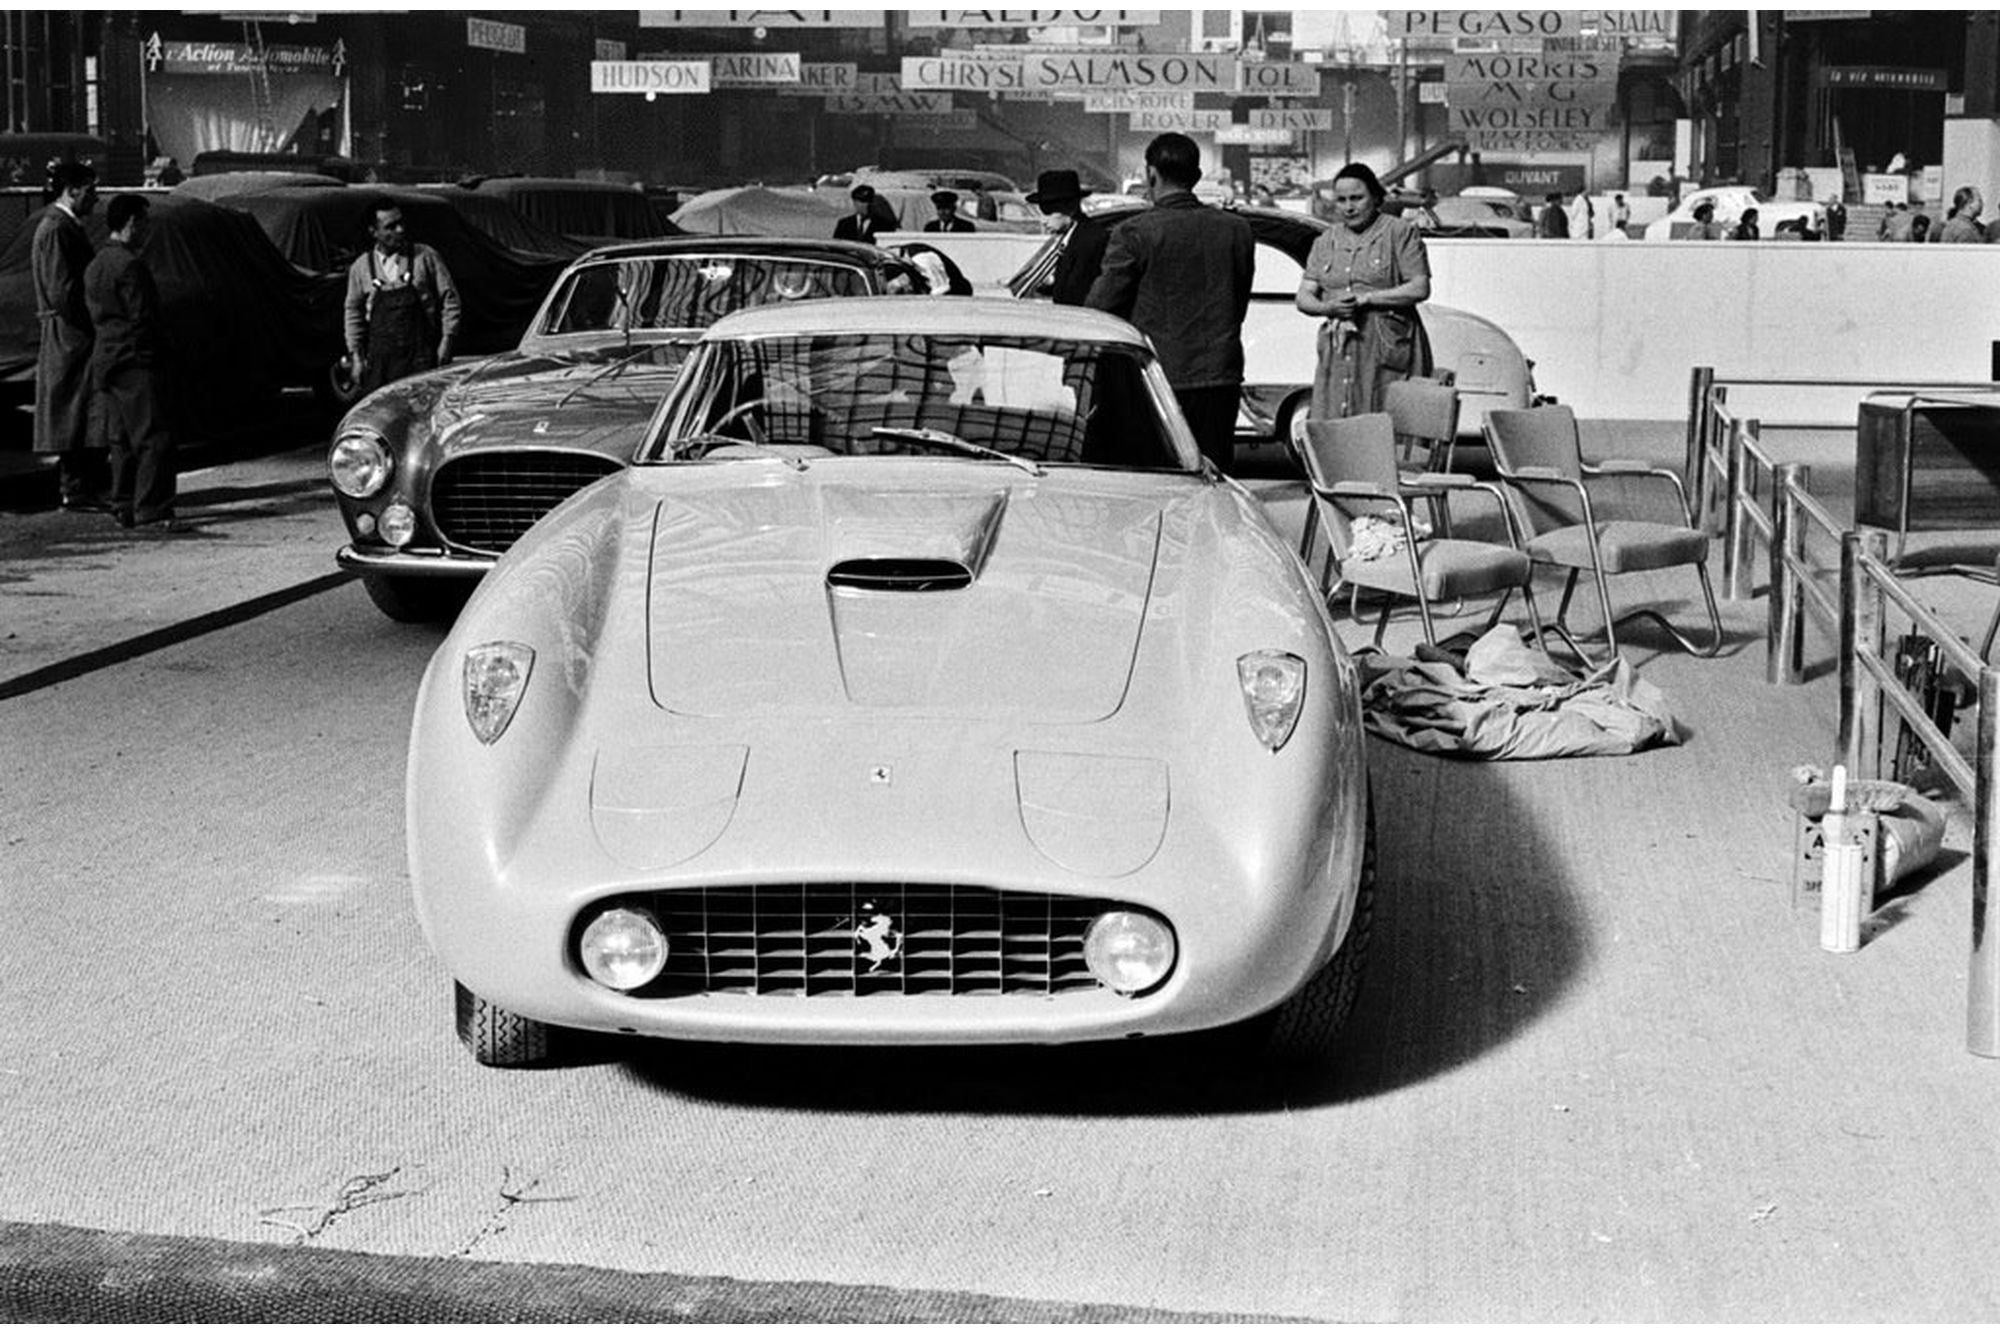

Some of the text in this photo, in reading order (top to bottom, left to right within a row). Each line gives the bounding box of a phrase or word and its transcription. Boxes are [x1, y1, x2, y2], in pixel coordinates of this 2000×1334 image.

[1406, 10, 1562, 35] PEGASO
[602, 64, 699, 88] HUDSON
[712, 56, 796, 78] FARINA
[1039, 57, 1217, 86] SALMSON
[1459, 56, 1598, 79] MORRIS
[1142, 113, 1220, 129] ROVER
[1460, 107, 1595, 129] WOLSELEY
